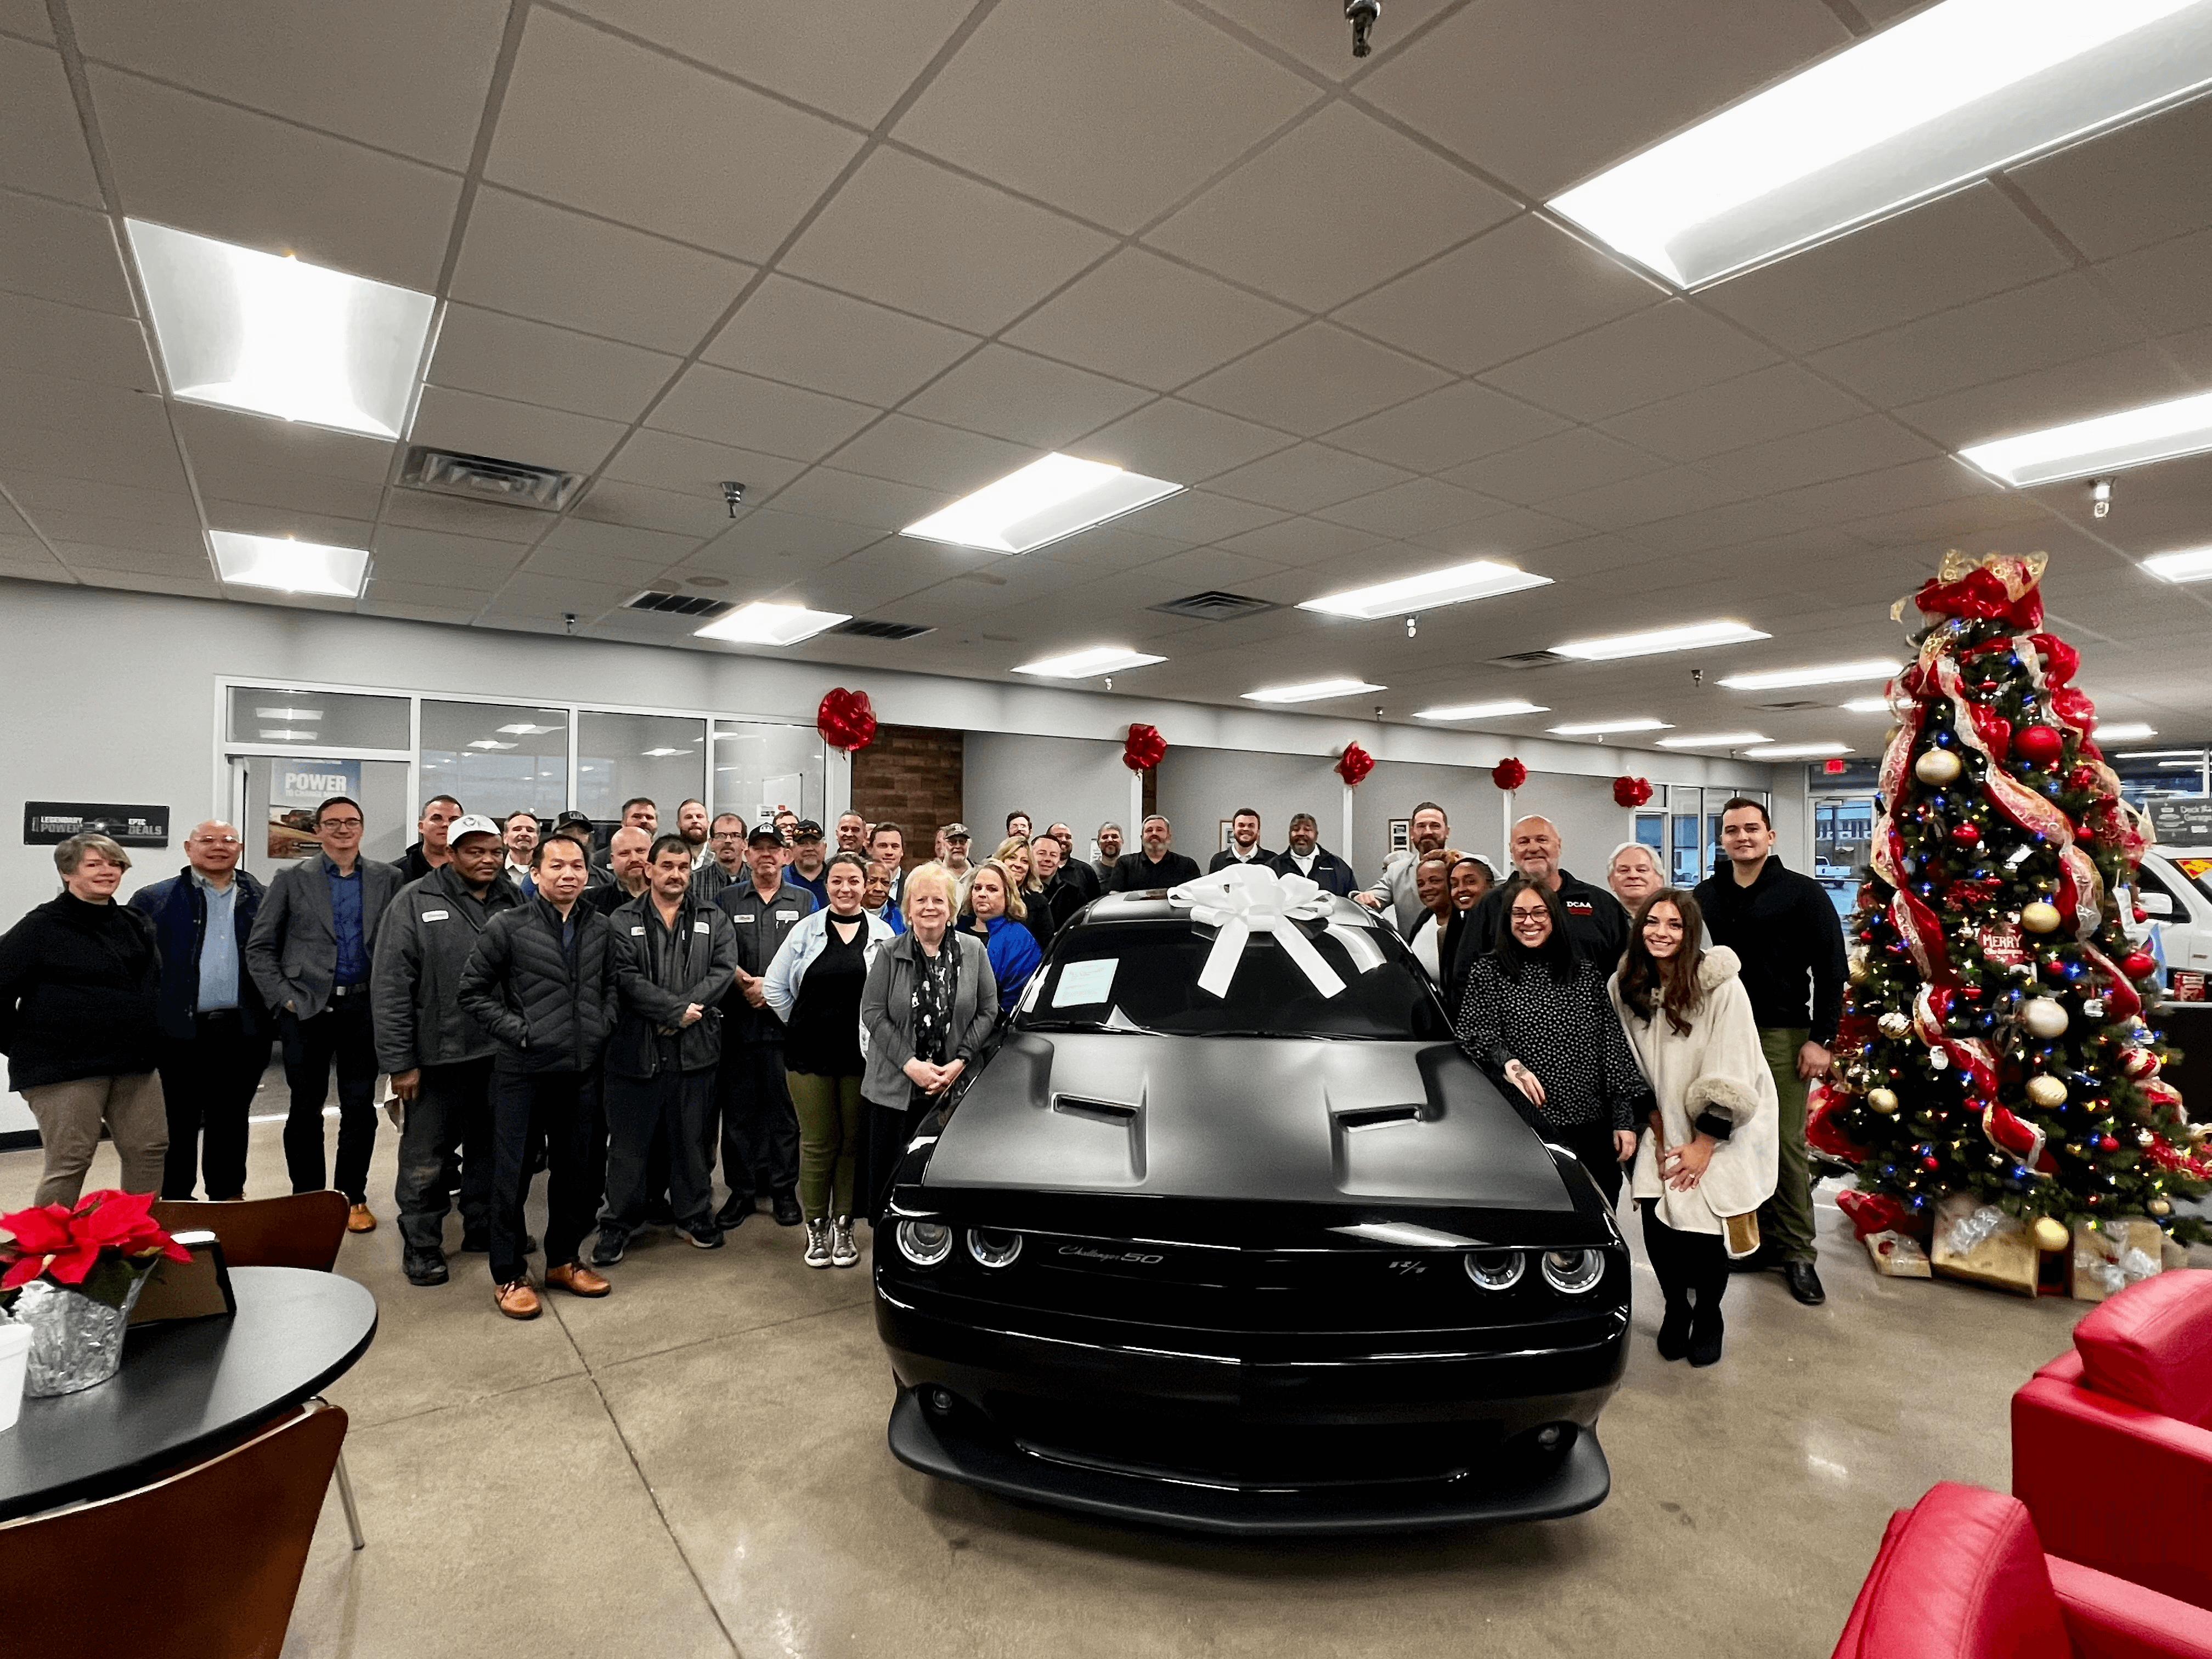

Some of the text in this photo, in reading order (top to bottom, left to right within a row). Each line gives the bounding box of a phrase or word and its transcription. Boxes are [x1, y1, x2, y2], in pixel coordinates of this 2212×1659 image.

[285, 773, 347, 791] POWER
[41, 824, 80, 832] POWER
[128, 825, 162, 835] DEALS
[1983, 934, 2023, 948] MERRY
[1120, 1252, 1164, 1263] 50
